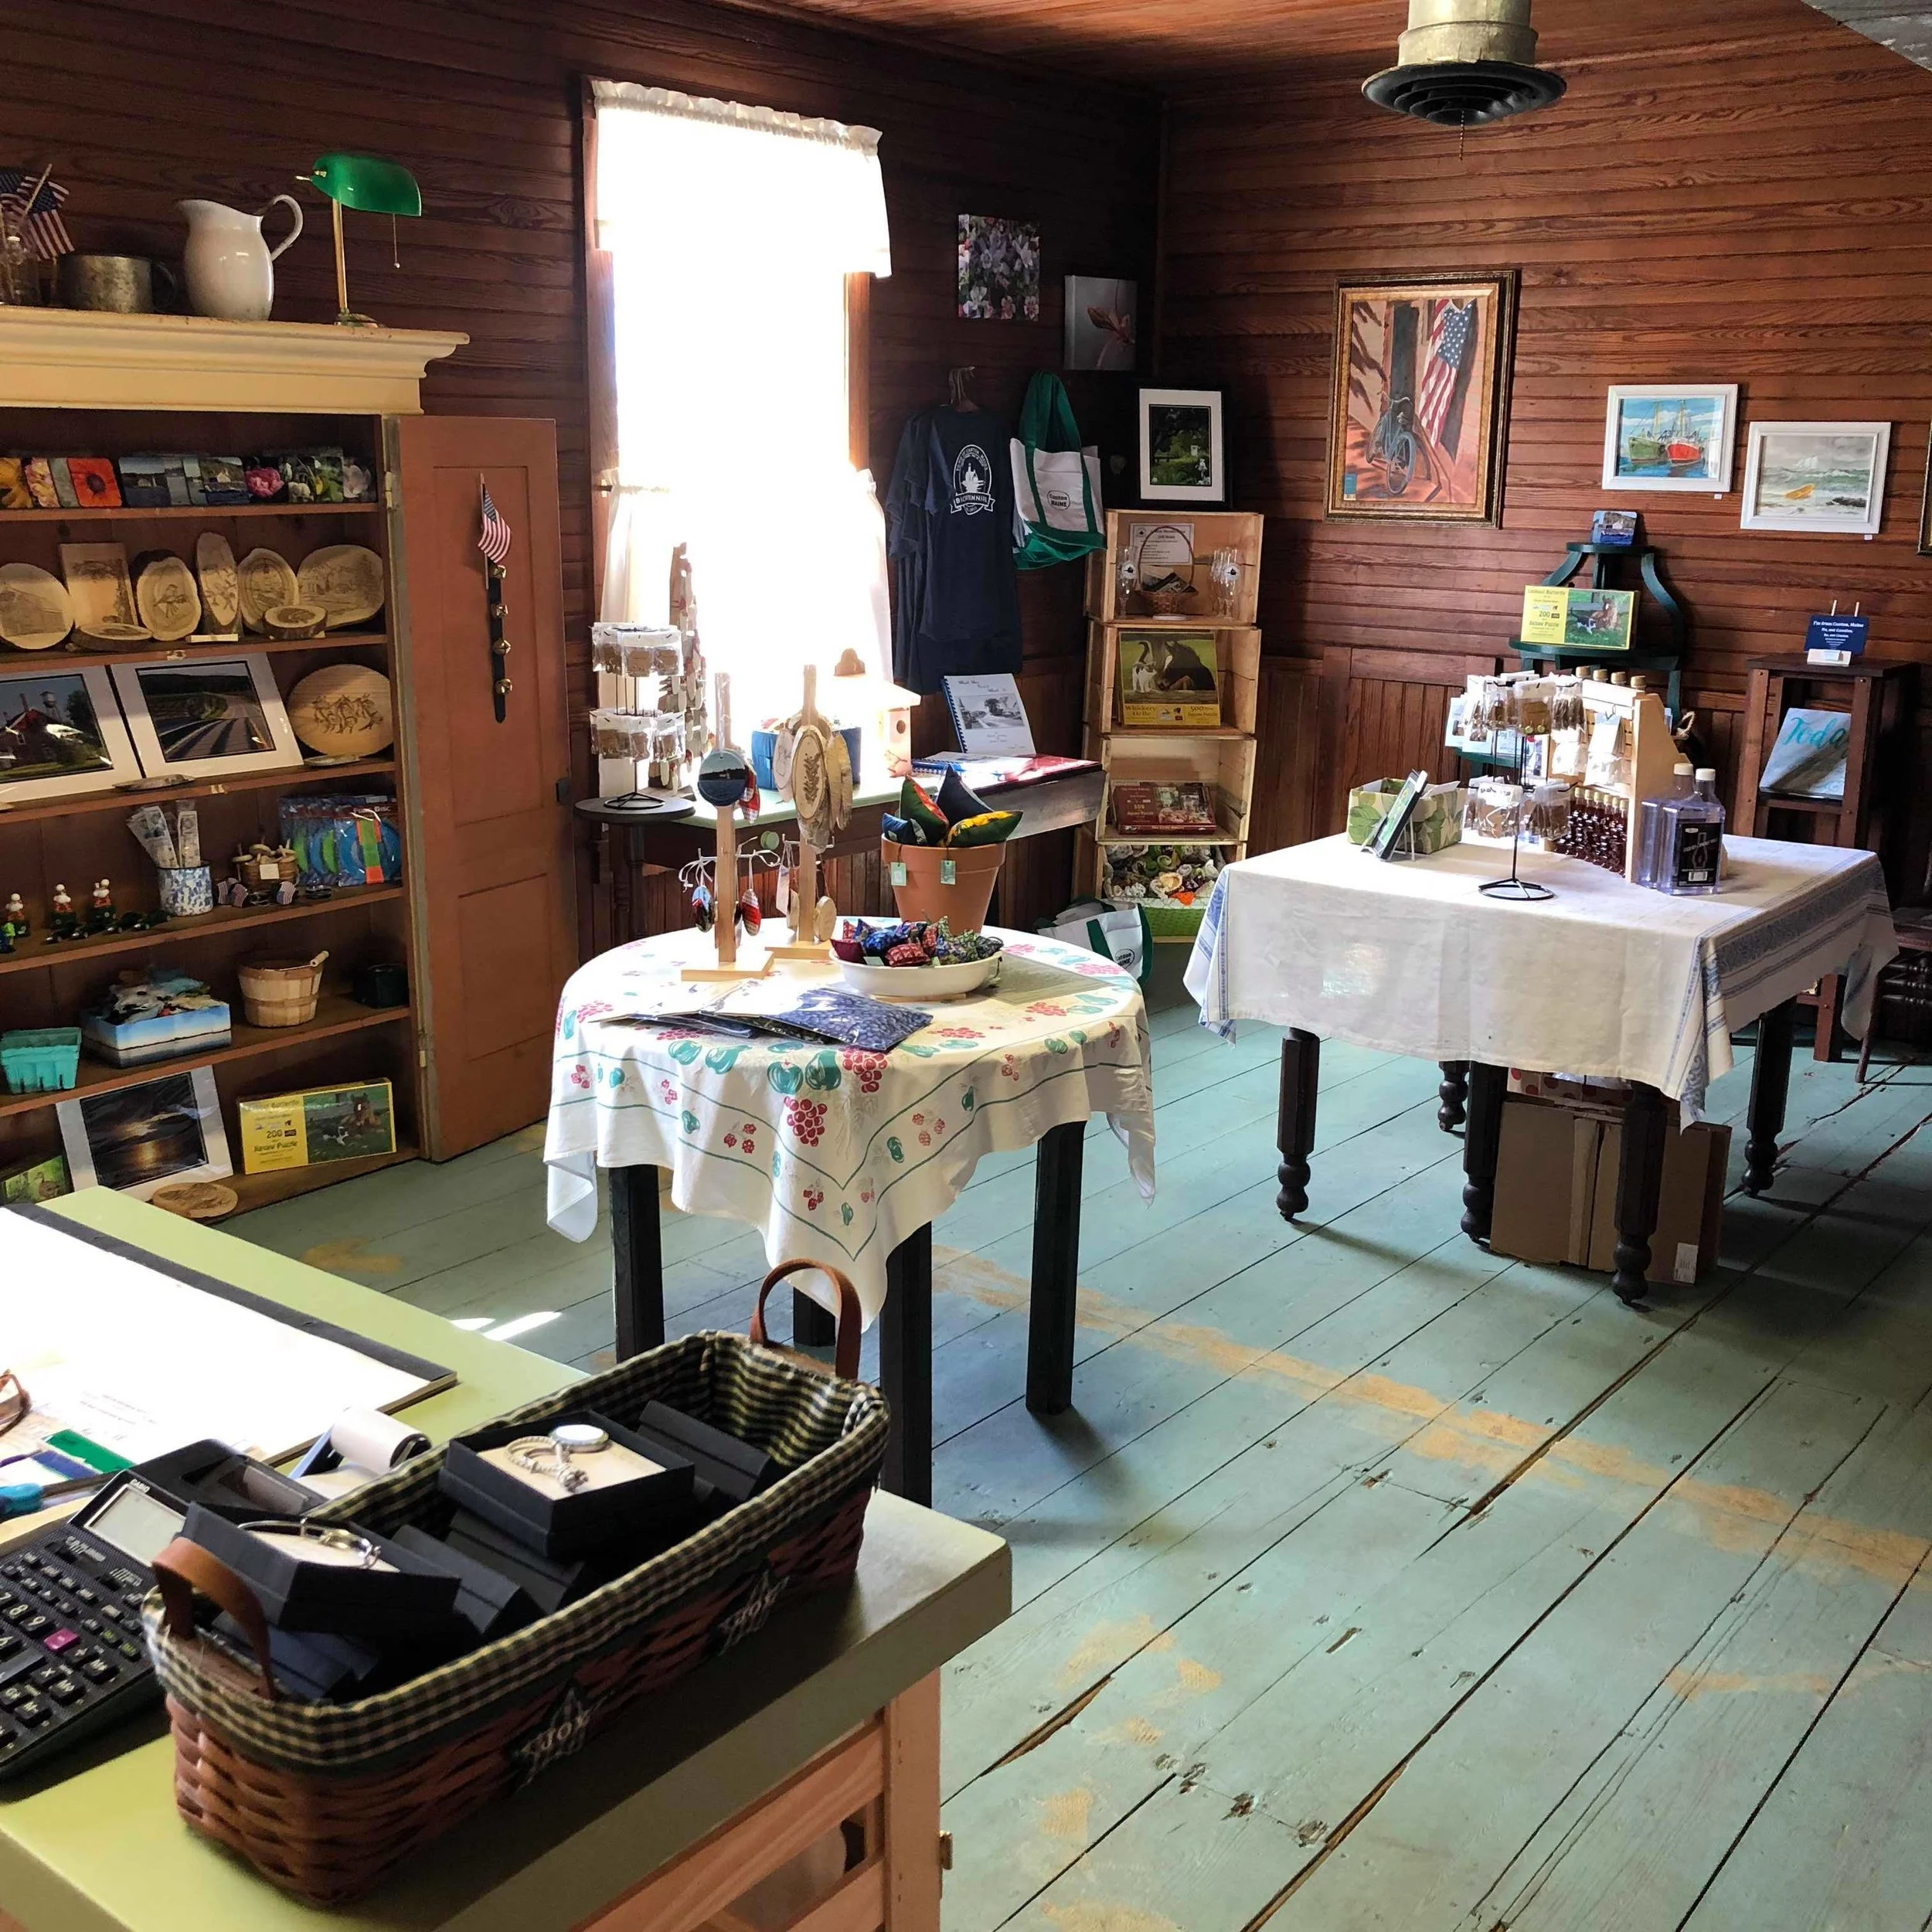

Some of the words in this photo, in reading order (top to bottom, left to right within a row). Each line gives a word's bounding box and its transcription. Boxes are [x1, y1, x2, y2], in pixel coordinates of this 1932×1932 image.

[1782, 717, 1849, 759] Toda
[266, 1129, 283, 1138] 200
[130, 1478, 151, 1493] CASIO
[9, 1604, 29, 1616] 8
[28, 1616, 46, 1627] 9
